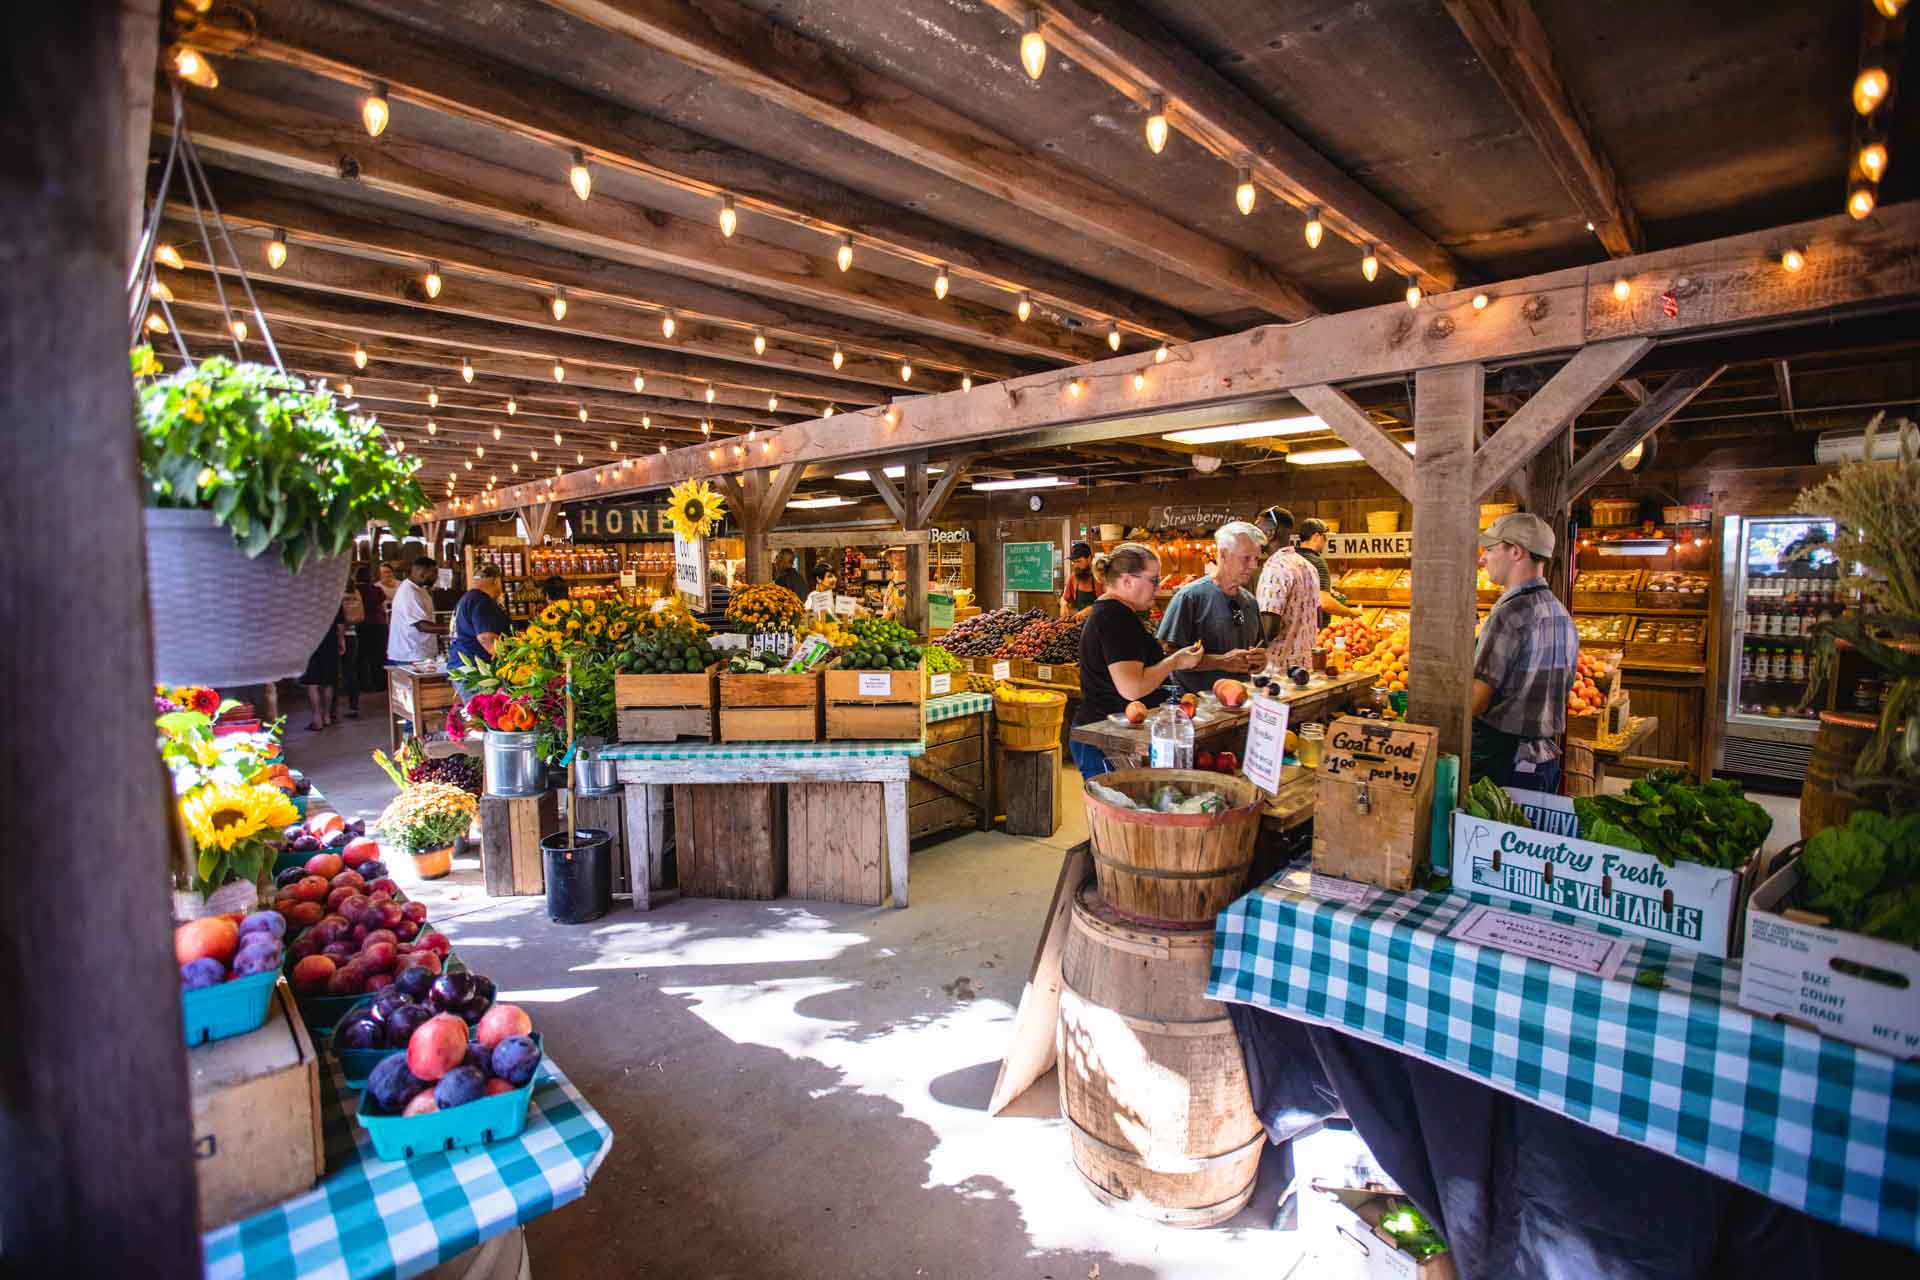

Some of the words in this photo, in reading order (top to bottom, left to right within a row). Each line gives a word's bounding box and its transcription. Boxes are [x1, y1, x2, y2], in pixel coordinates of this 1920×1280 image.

[580, 509, 673, 535] HONE
[931, 527, 970, 543] Beach
[1344, 537, 1412, 554] MARKET
[1332, 731, 1373, 753] Goat
[1377, 737, 1415, 759] food
[1369, 768, 1393, 781] per
[1393, 766, 1417, 787] bag
[1501, 831, 1594, 872] Country
[1602, 854, 1668, 888] Fresh
[1801, 970, 1831, 988] SIZE
[1801, 986, 1846, 1009] COUNT
[1799, 1003, 1844, 1024] GRADE
[1872, 1025, 1900, 1041] NET
